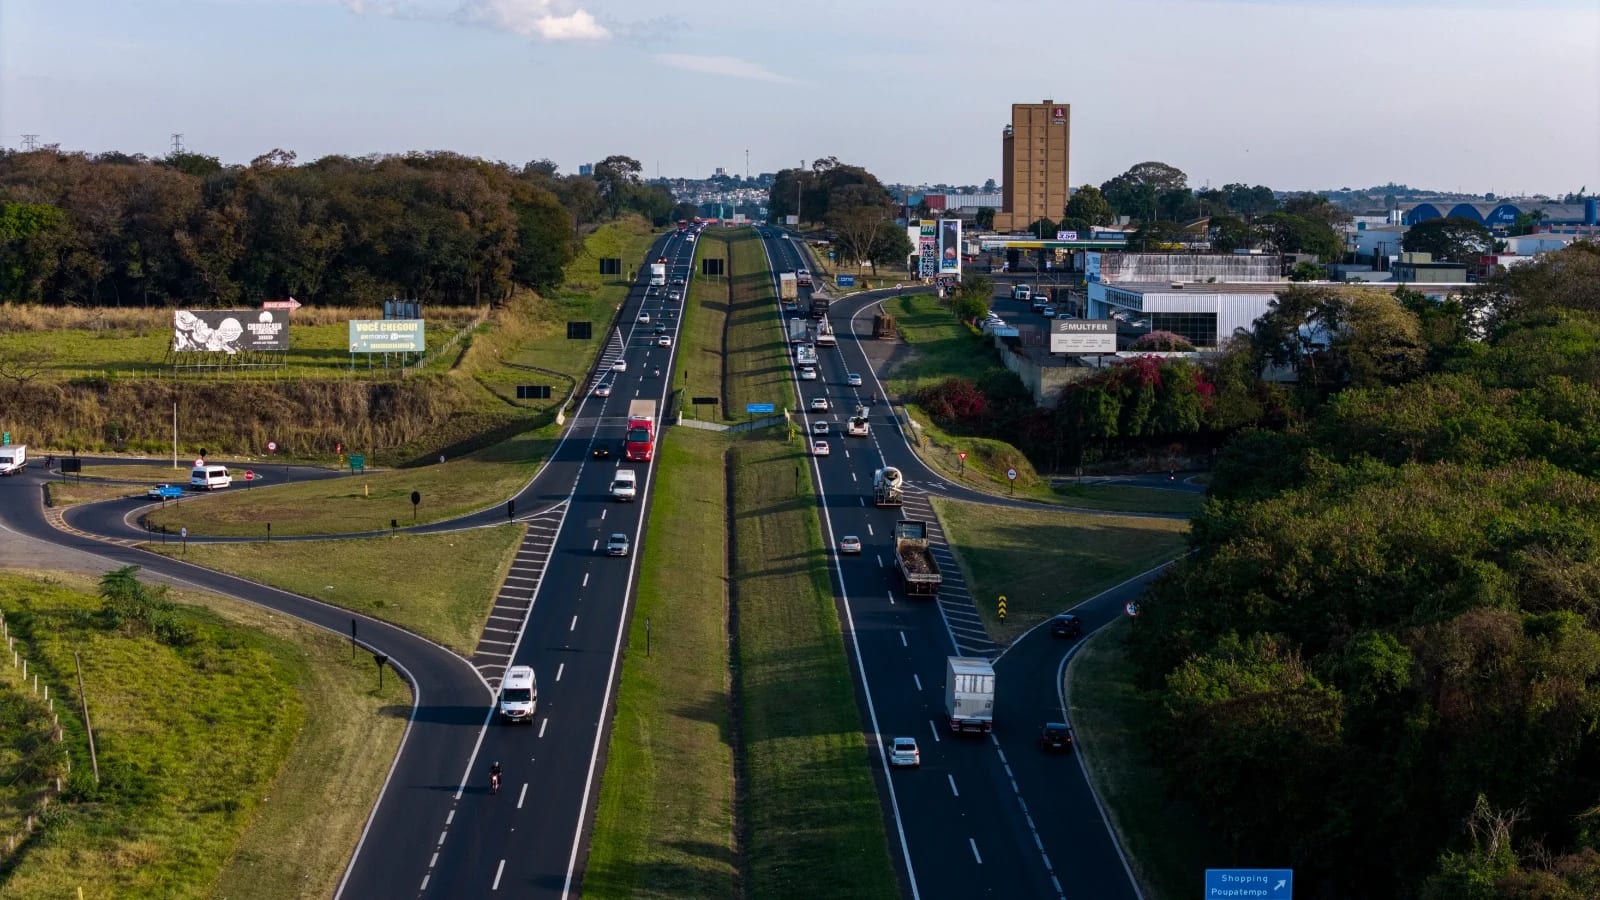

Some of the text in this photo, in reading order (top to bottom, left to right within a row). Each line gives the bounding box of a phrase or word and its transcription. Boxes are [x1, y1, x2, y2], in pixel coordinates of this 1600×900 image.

[356, 322, 418, 331] VOCÊ CHEGOU!
[1068, 323, 1108, 331] MULTFER
[1221, 874, 1268, 884] Shopping
[1211, 887, 1268, 896] Poupatempo
